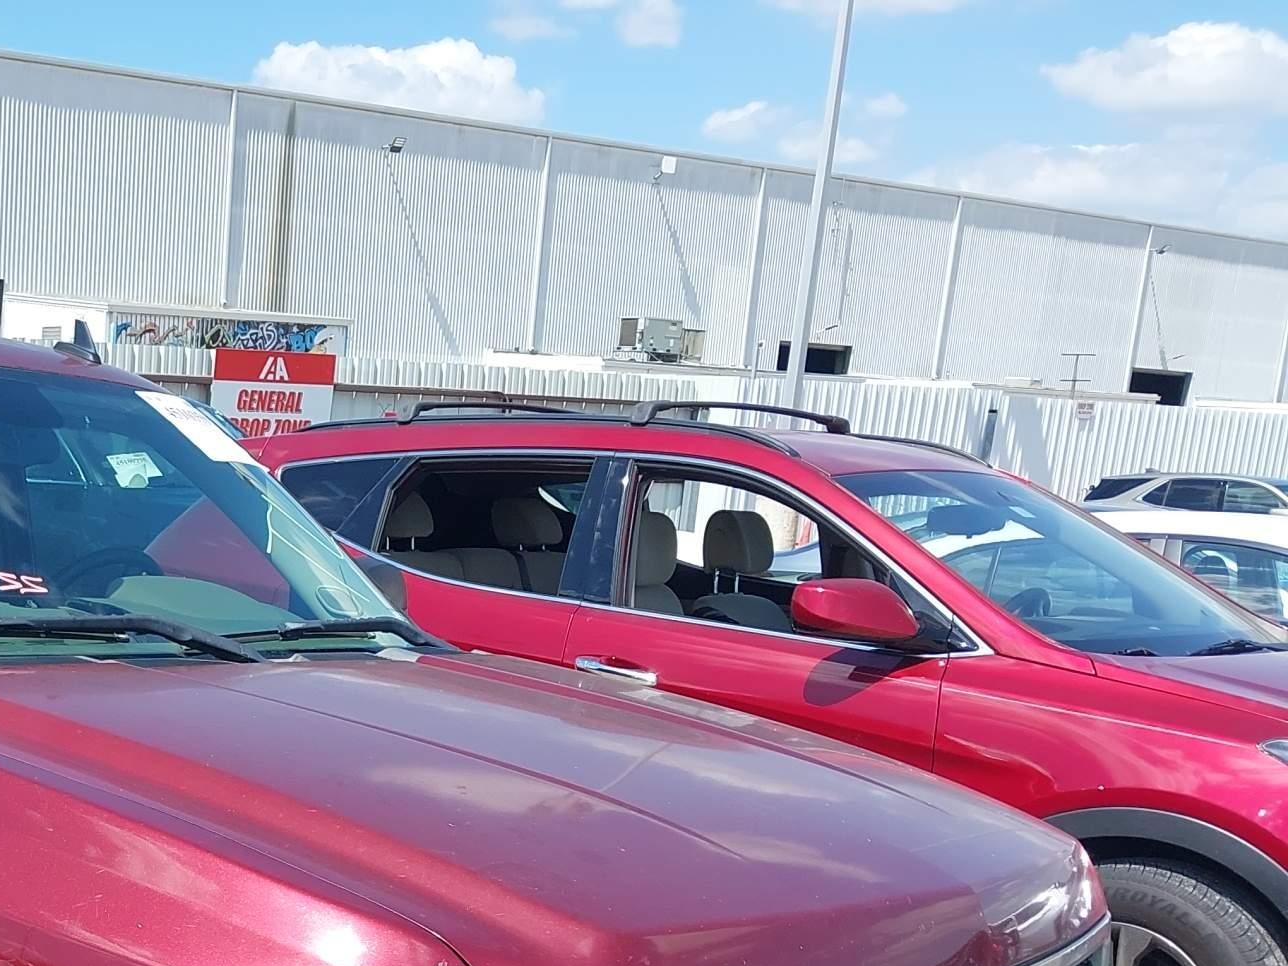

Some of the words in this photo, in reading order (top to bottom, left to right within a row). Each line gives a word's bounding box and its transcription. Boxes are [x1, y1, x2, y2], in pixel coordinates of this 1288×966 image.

[258, 355, 289, 381] IAA
[237, 389, 304, 414] GENERAL
[272, 418, 312, 435] ZO
